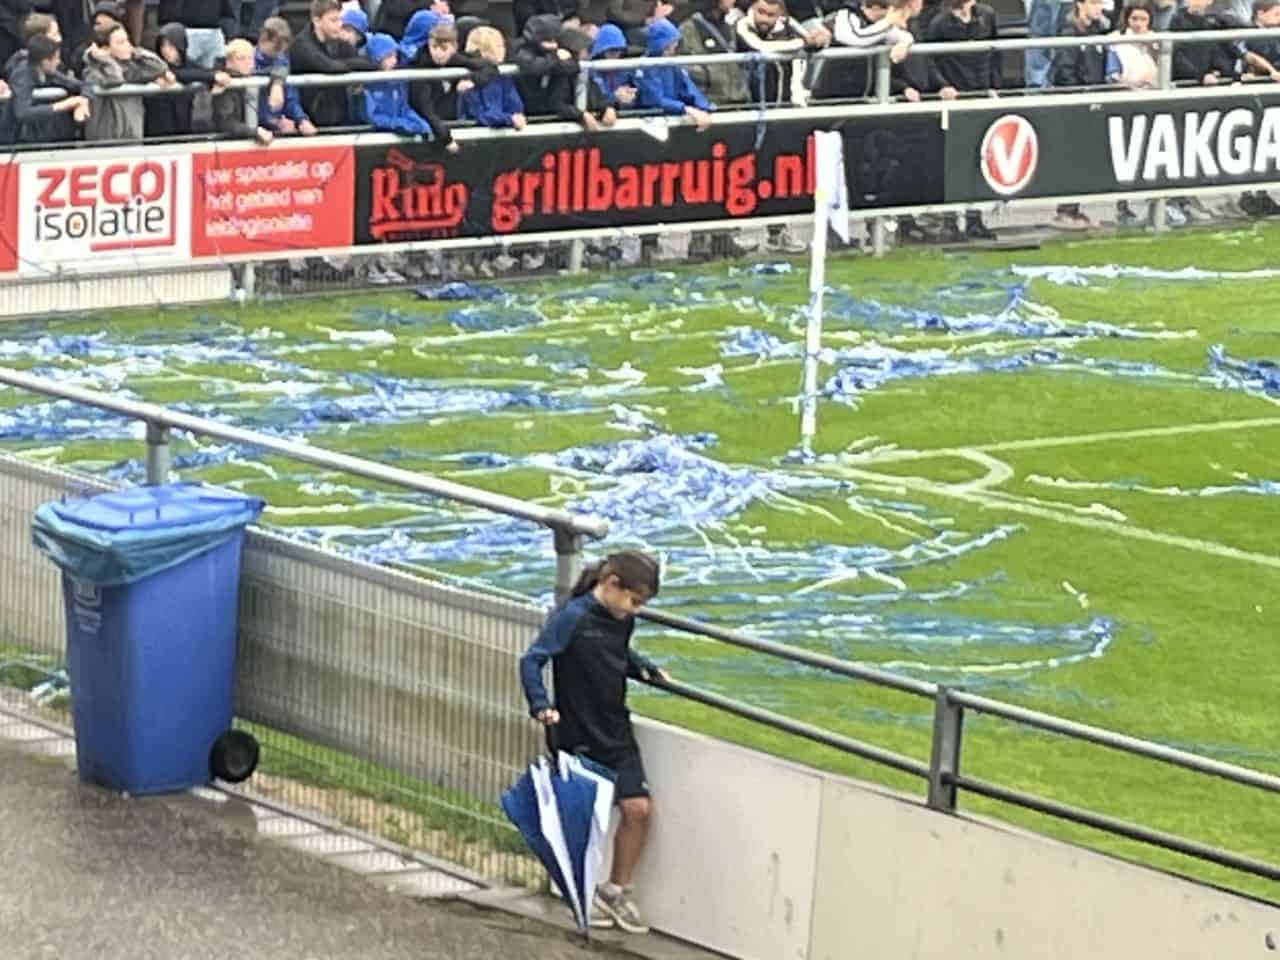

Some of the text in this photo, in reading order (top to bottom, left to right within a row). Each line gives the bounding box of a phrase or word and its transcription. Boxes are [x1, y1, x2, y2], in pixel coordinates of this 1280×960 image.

[36, 160, 166, 209] ZECO
[490, 133, 816, 233] grillbarruig.nl
[34, 197, 166, 243] isolatie
